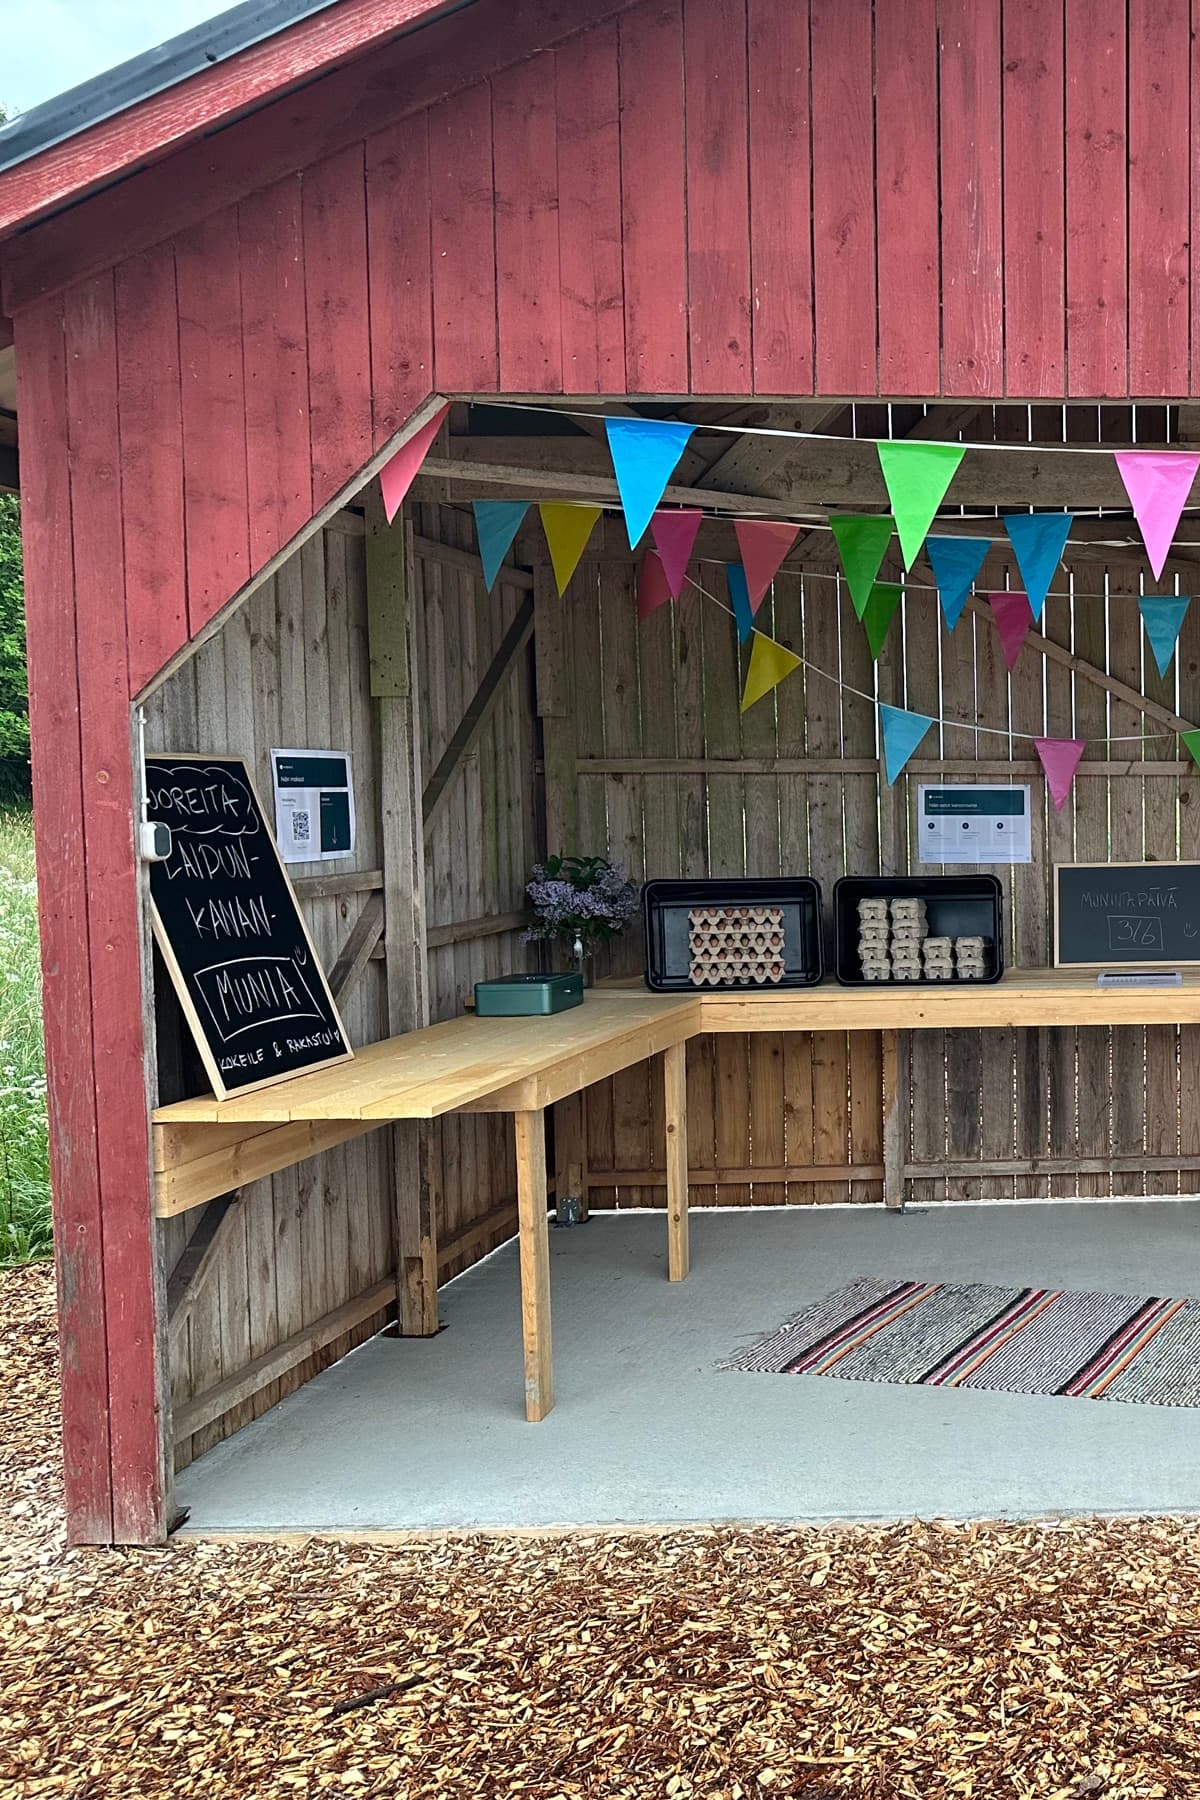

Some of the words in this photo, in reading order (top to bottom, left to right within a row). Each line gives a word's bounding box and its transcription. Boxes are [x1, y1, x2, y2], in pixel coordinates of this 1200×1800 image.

[185, 895, 277, 940] KANAN-
[1117, 919, 1156, 945] 3/6
[216, 966, 302, 1022] MUNIA
[218, 1048, 264, 1073] KOKEILE
[272, 1041, 283, 1058] &
